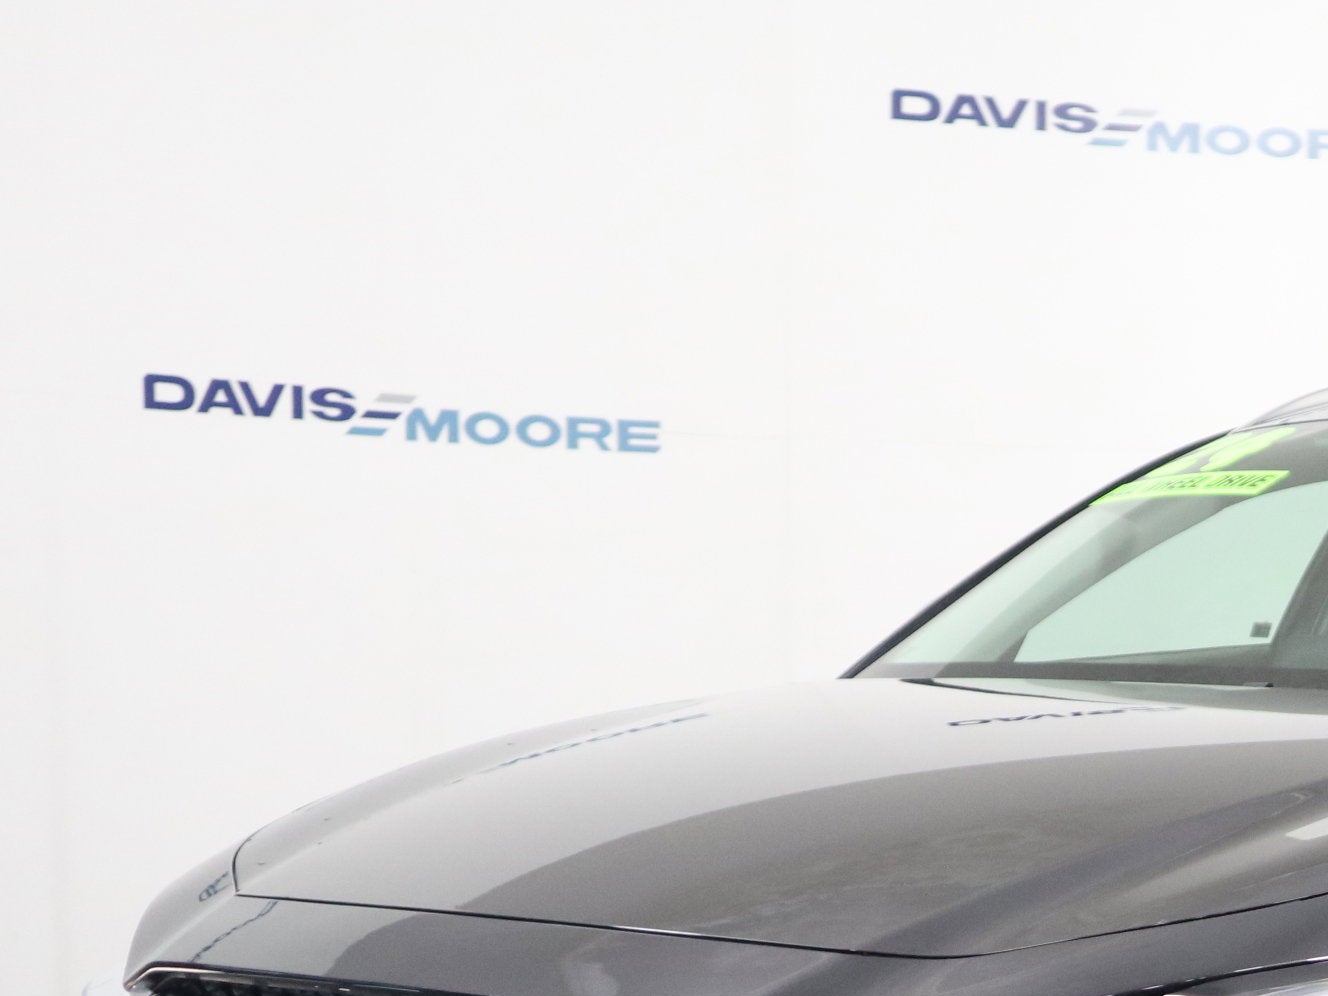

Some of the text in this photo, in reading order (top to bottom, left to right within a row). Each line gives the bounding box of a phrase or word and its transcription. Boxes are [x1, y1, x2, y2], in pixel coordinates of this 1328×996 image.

[888, 88, 1101, 132] DAVIS
[143, 373, 662, 454] DAVIS MOORE
